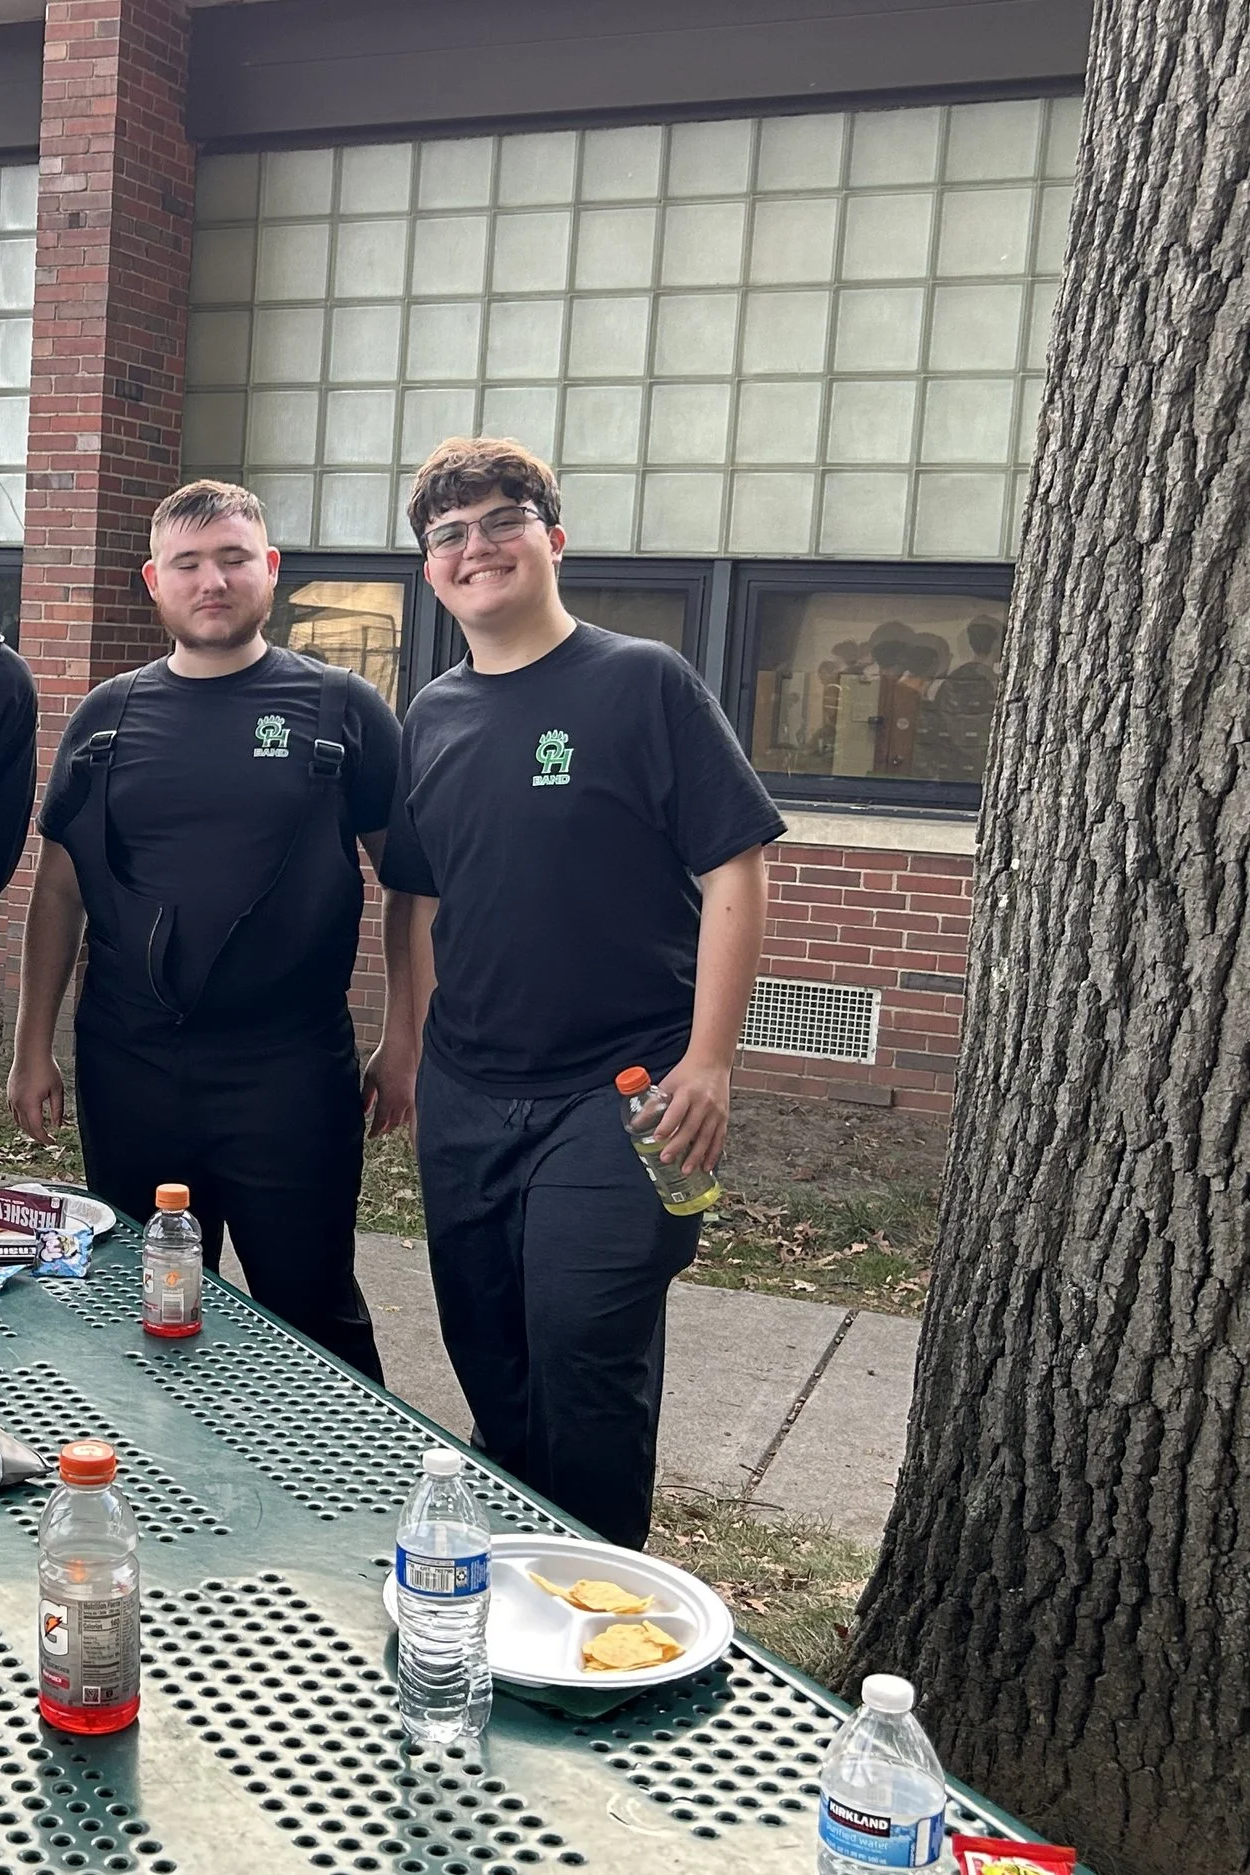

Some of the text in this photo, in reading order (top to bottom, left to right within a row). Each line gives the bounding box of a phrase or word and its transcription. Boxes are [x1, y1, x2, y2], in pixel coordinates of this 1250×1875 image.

[253, 748, 289, 758] BAND
[532, 774, 571, 787] BAND
[829, 1800, 889, 1831] KIRKLAND
